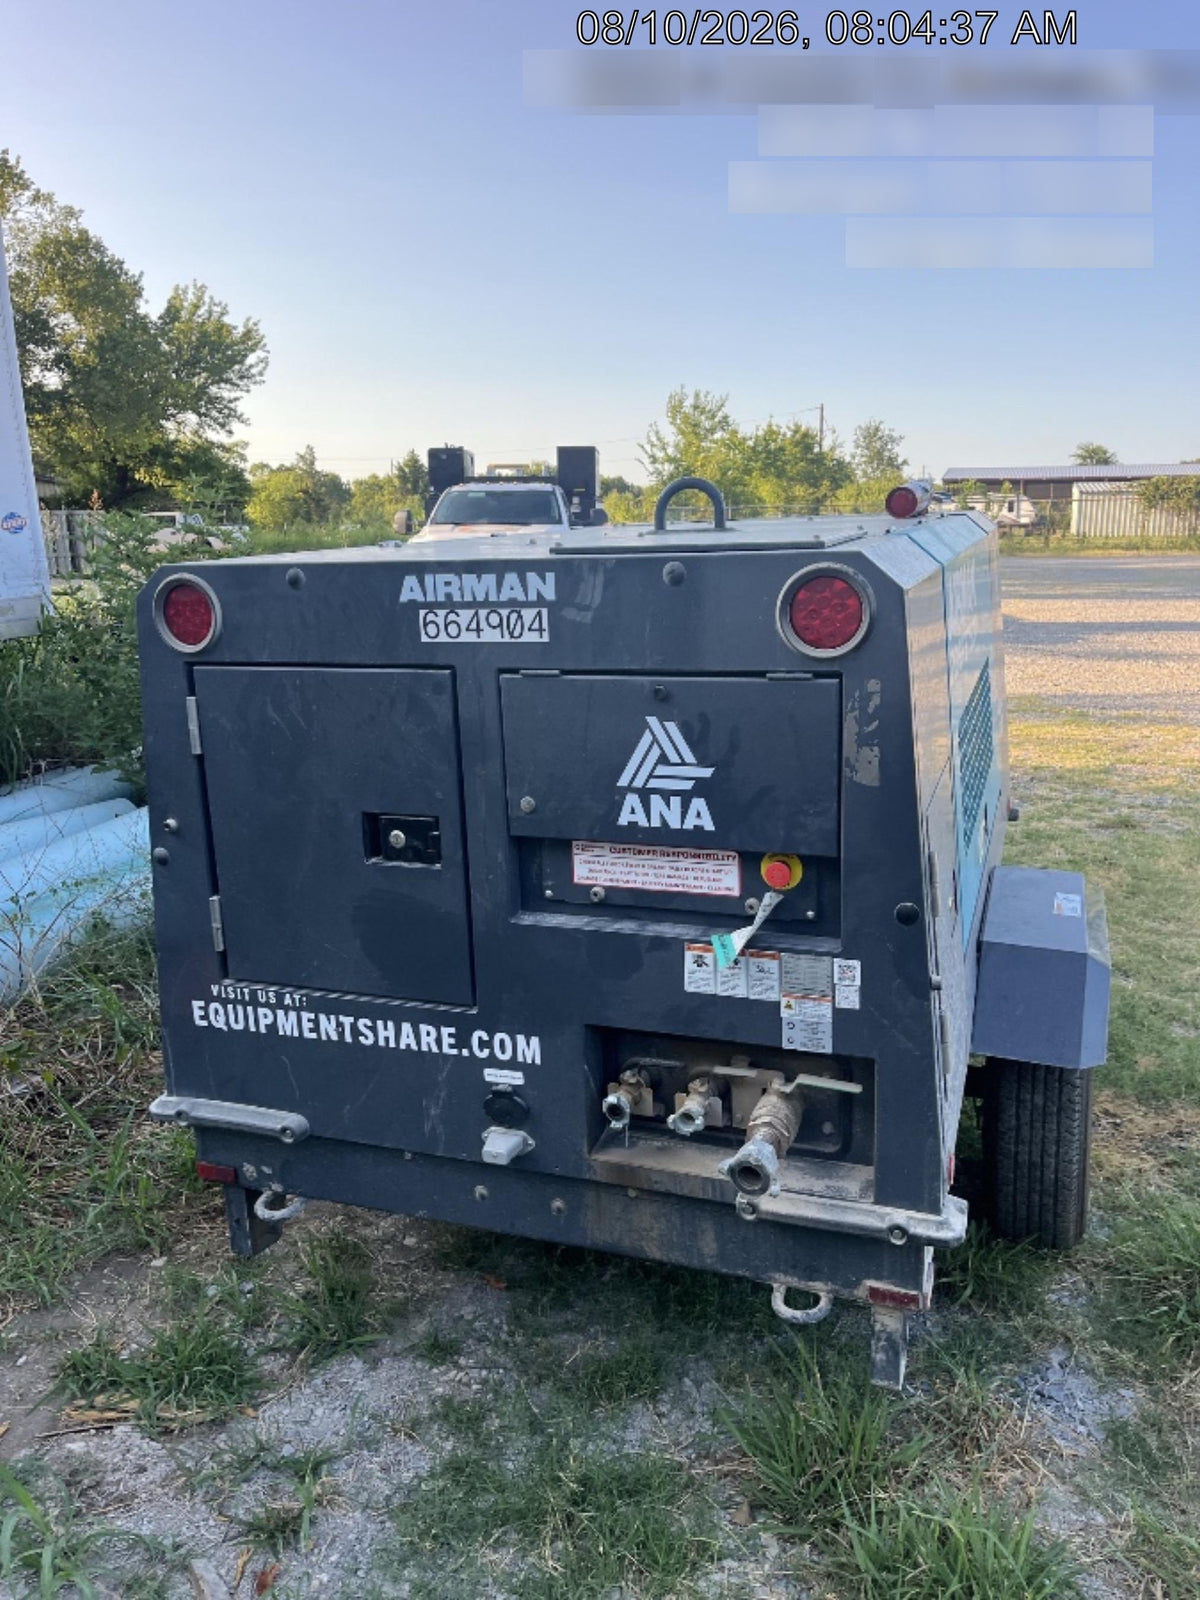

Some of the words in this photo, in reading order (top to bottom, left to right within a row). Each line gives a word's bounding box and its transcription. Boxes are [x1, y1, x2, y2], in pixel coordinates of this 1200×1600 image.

[399, 572, 557, 602] AIRMAN
[422, 609, 547, 639] 664904
[616, 792, 716, 831] ANA
[210, 984, 250, 1001] VISIT
[257, 990, 277, 1004] US
[283, 993, 307, 1007] AT:
[191, 999, 543, 1066] EQUIPMENTSHARE.COM
